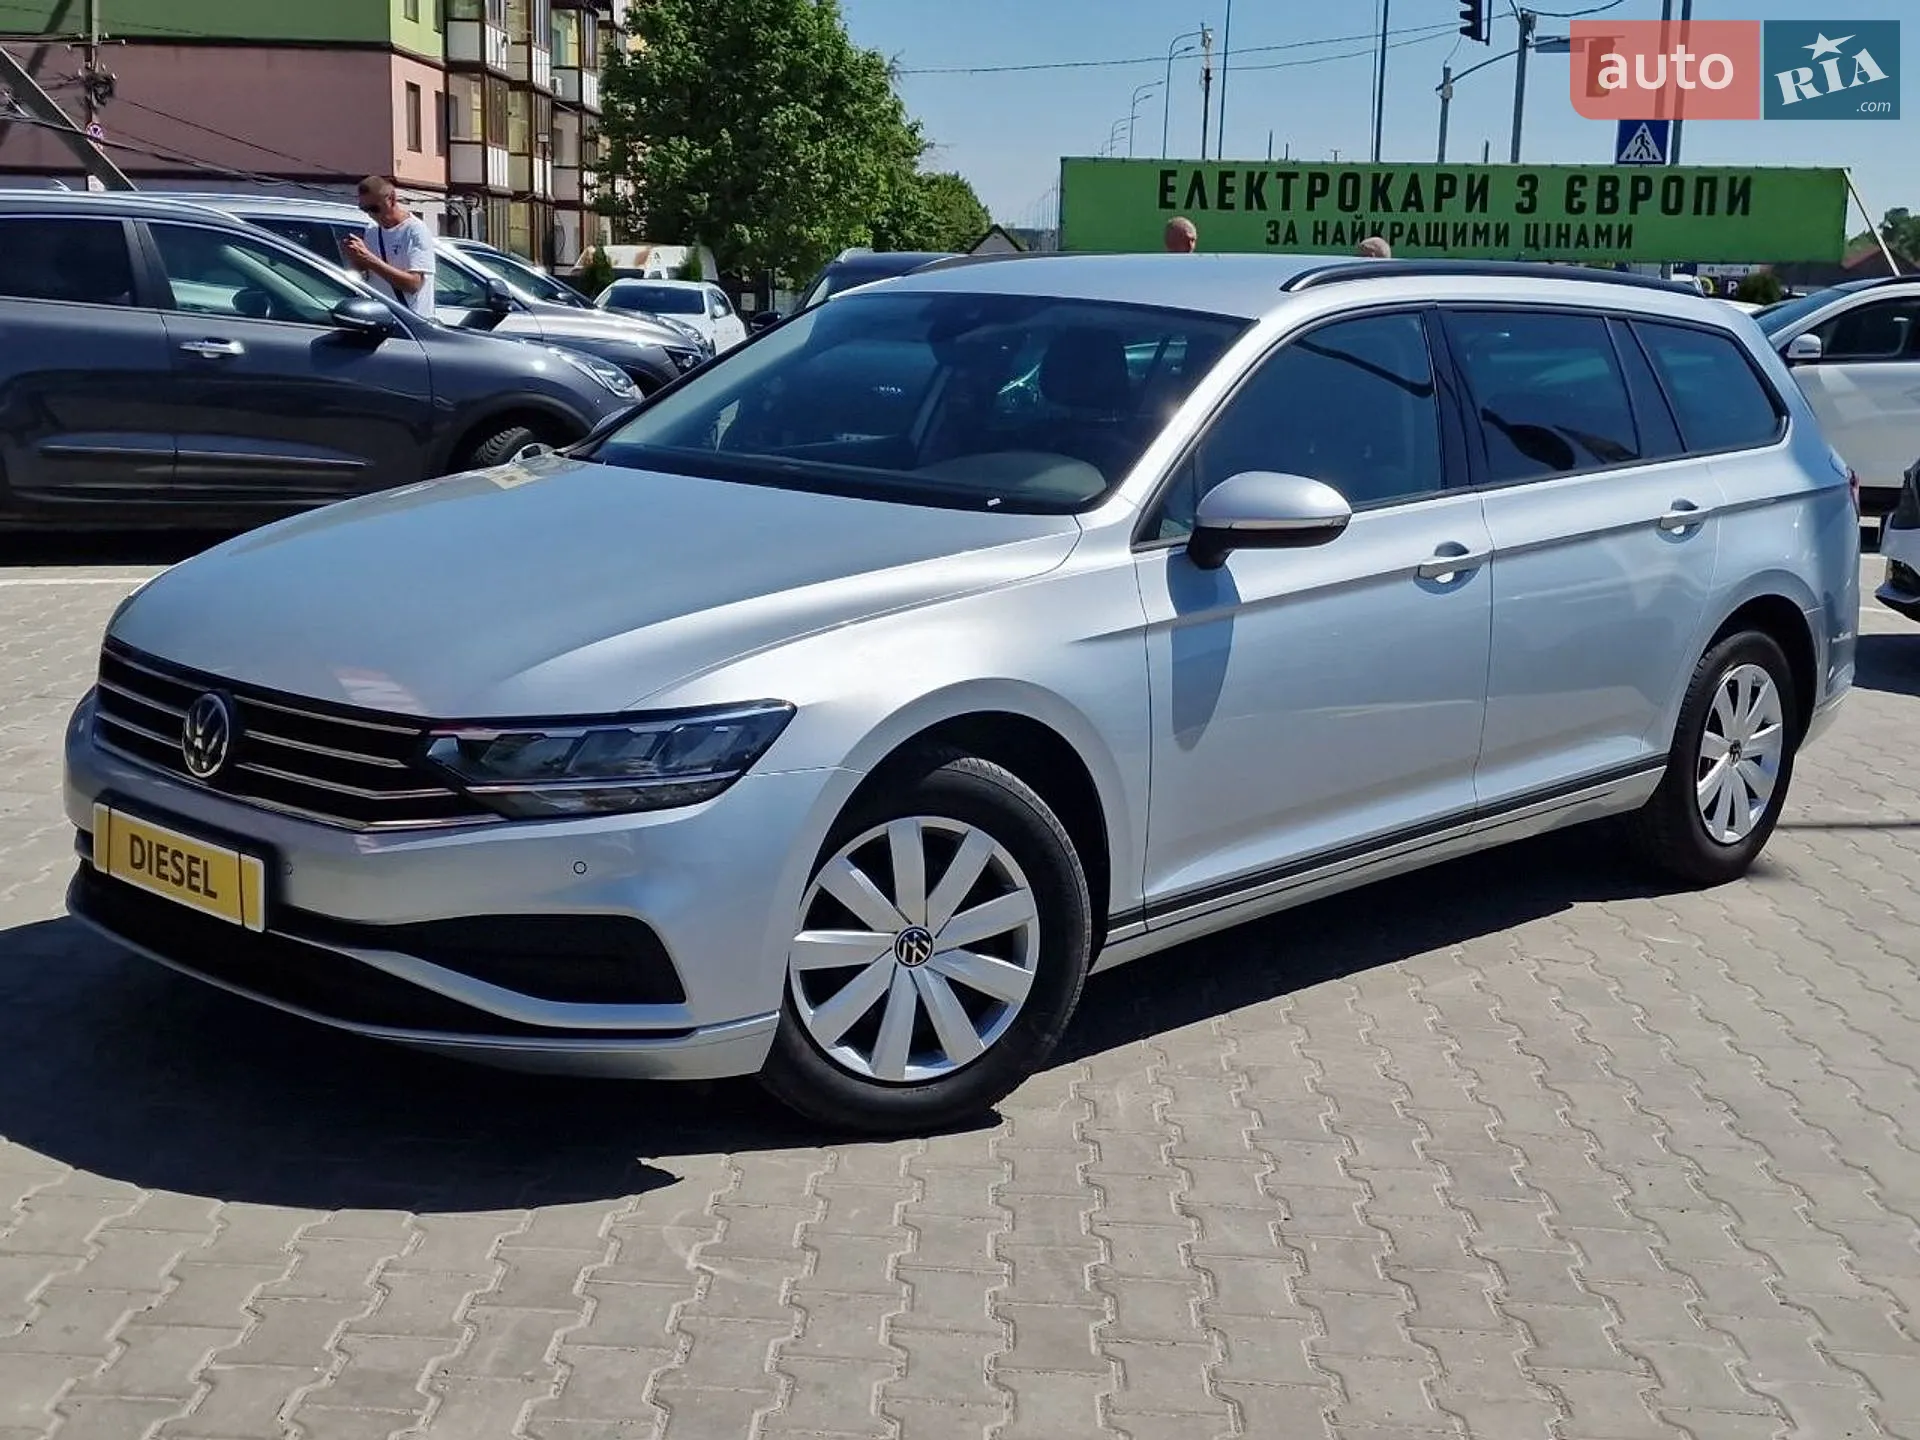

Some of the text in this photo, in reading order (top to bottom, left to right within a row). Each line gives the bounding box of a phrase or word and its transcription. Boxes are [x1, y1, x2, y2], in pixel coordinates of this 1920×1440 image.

[1158, 169, 1489, 213] ЕЛЕКТРОКАРИ
[1565, 173, 1752, 216] ЄВРОПИ
[1265, 214, 1634, 251] ЗА НАЙКРАЩИМИ ЦІНАМИ
[129, 833, 217, 900] DIESEL
